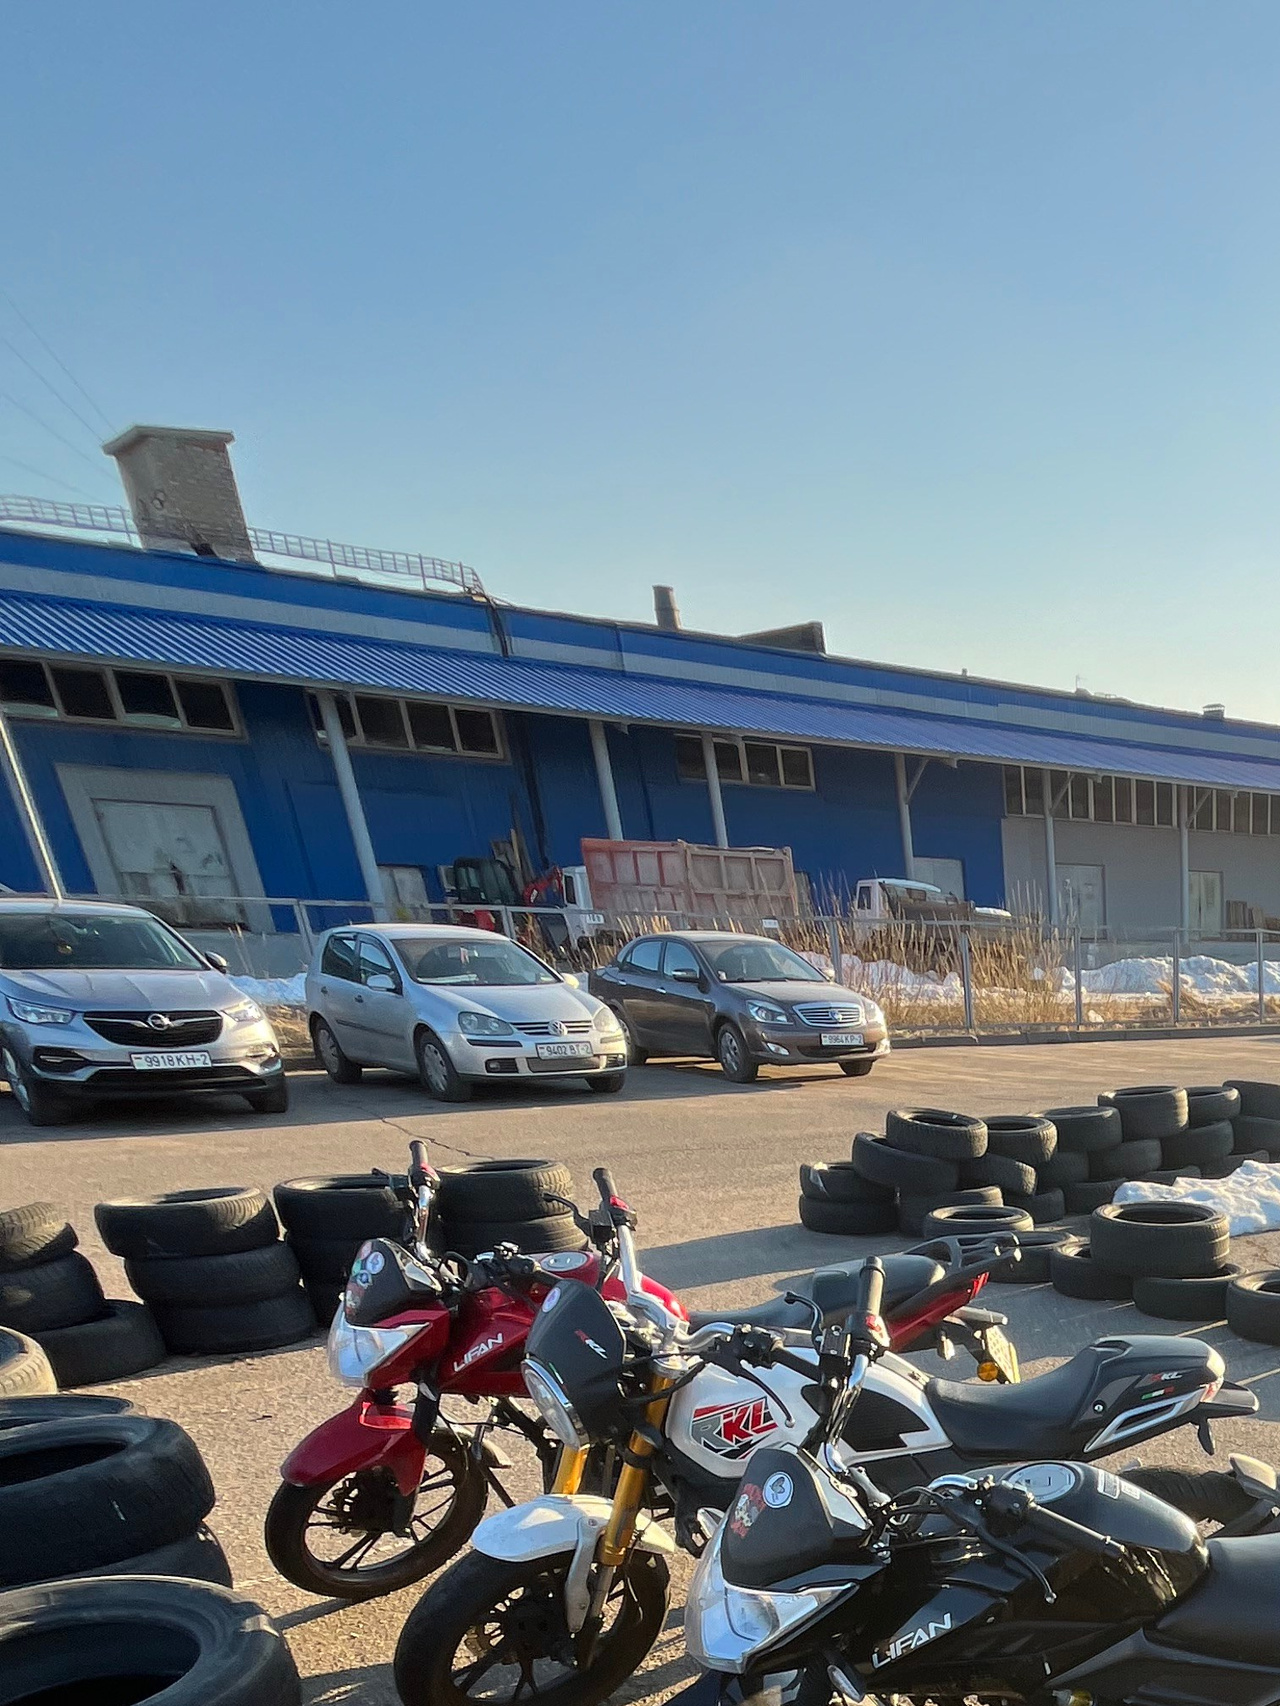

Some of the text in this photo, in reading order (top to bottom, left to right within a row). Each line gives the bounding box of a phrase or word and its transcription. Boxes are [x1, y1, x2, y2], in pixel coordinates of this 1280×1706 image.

[453, 1332, 503, 1372] LIFAN
[691, 1400, 779, 1448] RKL
[871, 1612, 952, 1669] LIFAN
